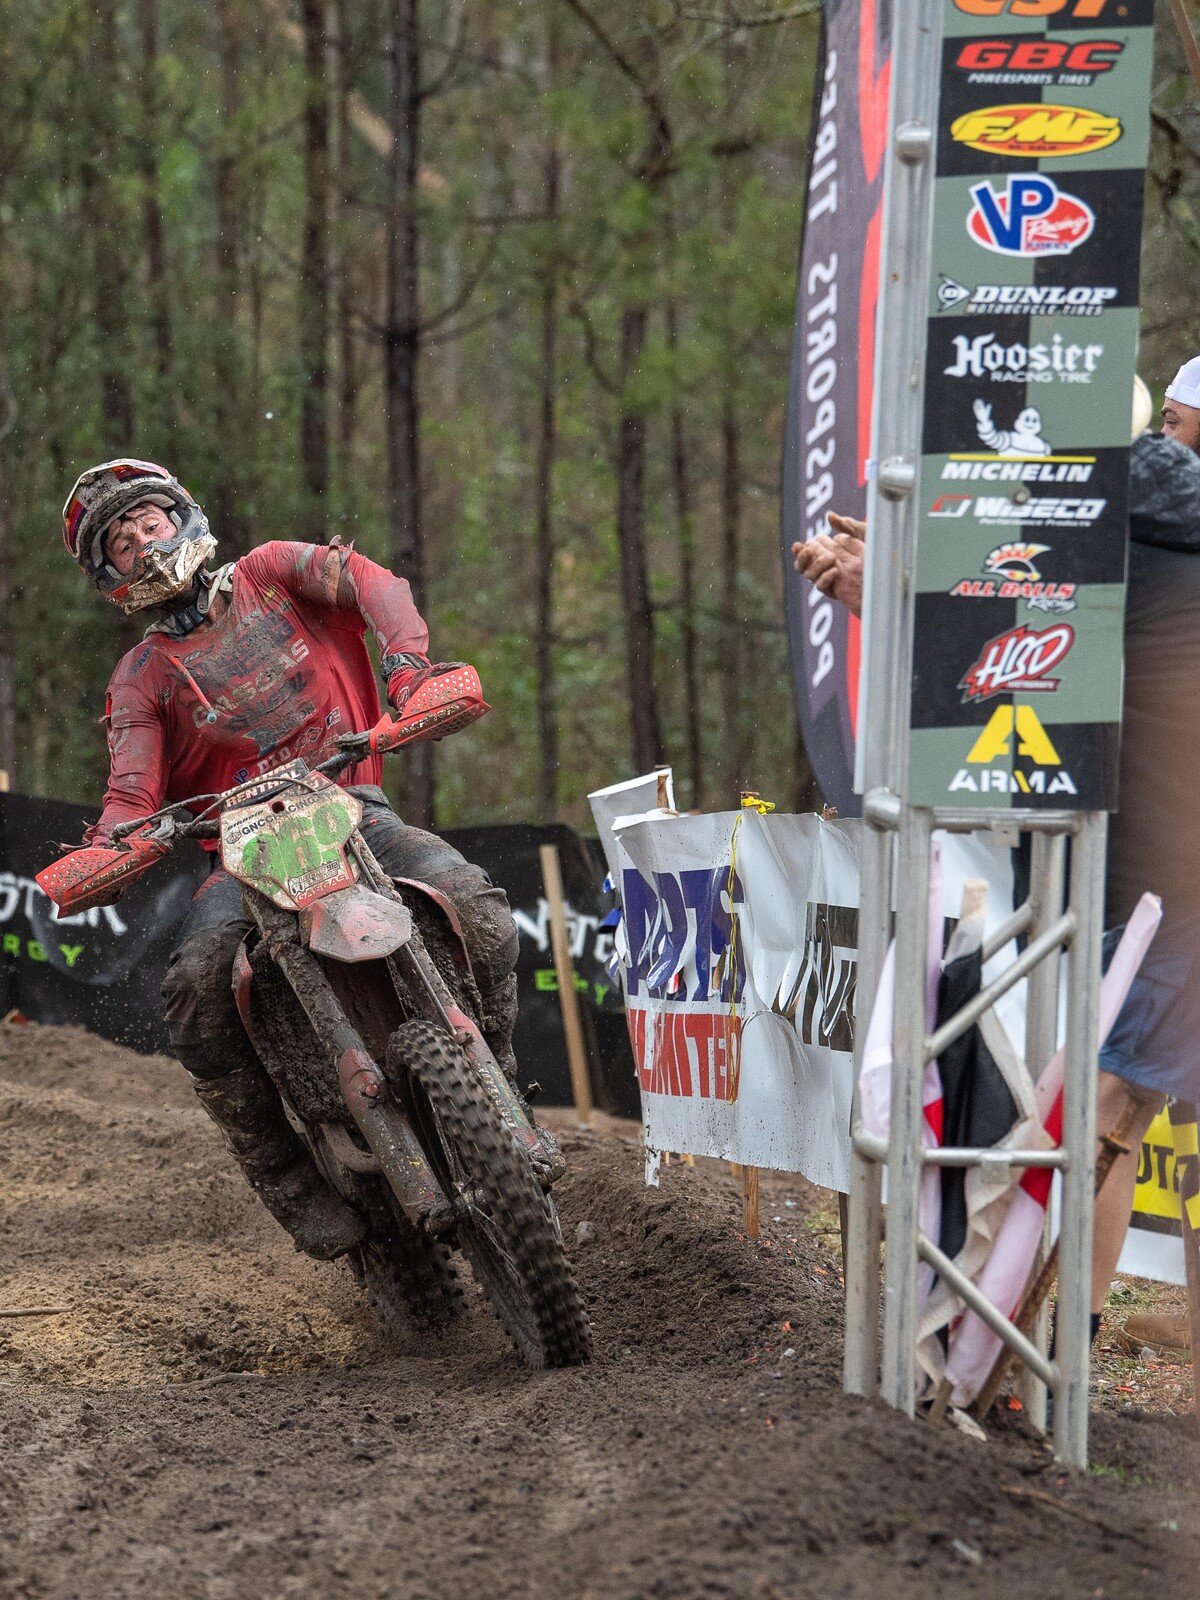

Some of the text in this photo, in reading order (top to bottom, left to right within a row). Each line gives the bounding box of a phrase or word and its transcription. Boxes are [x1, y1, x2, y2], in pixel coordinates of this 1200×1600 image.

[956, 41, 1122, 71] GBC
[967, 73, 1092, 85] POWERSPORTS TIRES
[952, 111, 1120, 144] FMF
[972, 178, 1056, 251] VP
[971, 285, 1119, 304] DUNLOP
[966, 304, 1103, 315] MOTORCYCLE TIRES
[943, 332, 1105, 377] Hoosier
[991, 371, 1092, 383] RACING TIRE
[941, 463, 1093, 482] MICHELIN
[949, 580, 1076, 598] ALL BALLS
[948, 770, 1078, 795] ARMA
